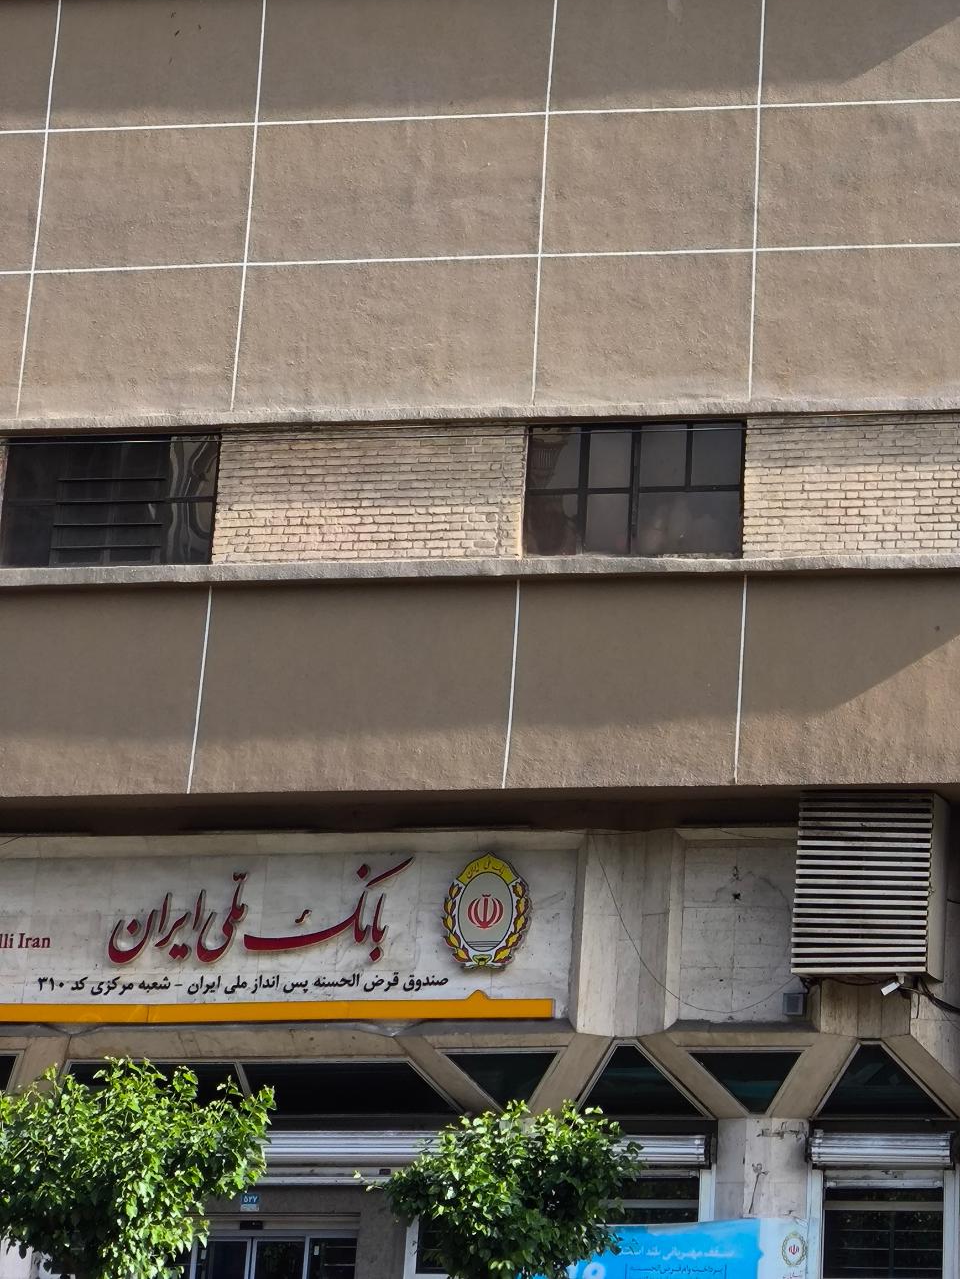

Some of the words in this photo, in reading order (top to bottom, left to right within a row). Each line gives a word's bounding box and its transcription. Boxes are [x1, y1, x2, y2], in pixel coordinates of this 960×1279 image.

[244, 856, 416, 963] بانک
[108, 889, 207, 965] ایران
[18, 933, 51, 949] Iran
[37, 977, 64, 991] ۳۱۰
[71, 976, 88, 990] کد
[90, 976, 134, 995] مرکزی
[138, 976, 171, 990] شعبه
[187, 975, 222, 994] ایران
[223, 974, 248, 995] ملی
[250, 974, 280, 994] انداز
[283, 977, 309, 993] پس
[313, 972, 361, 988] الحسنه
[363, 972, 399, 993] قرض
[402, 974, 449, 993] صندوق
